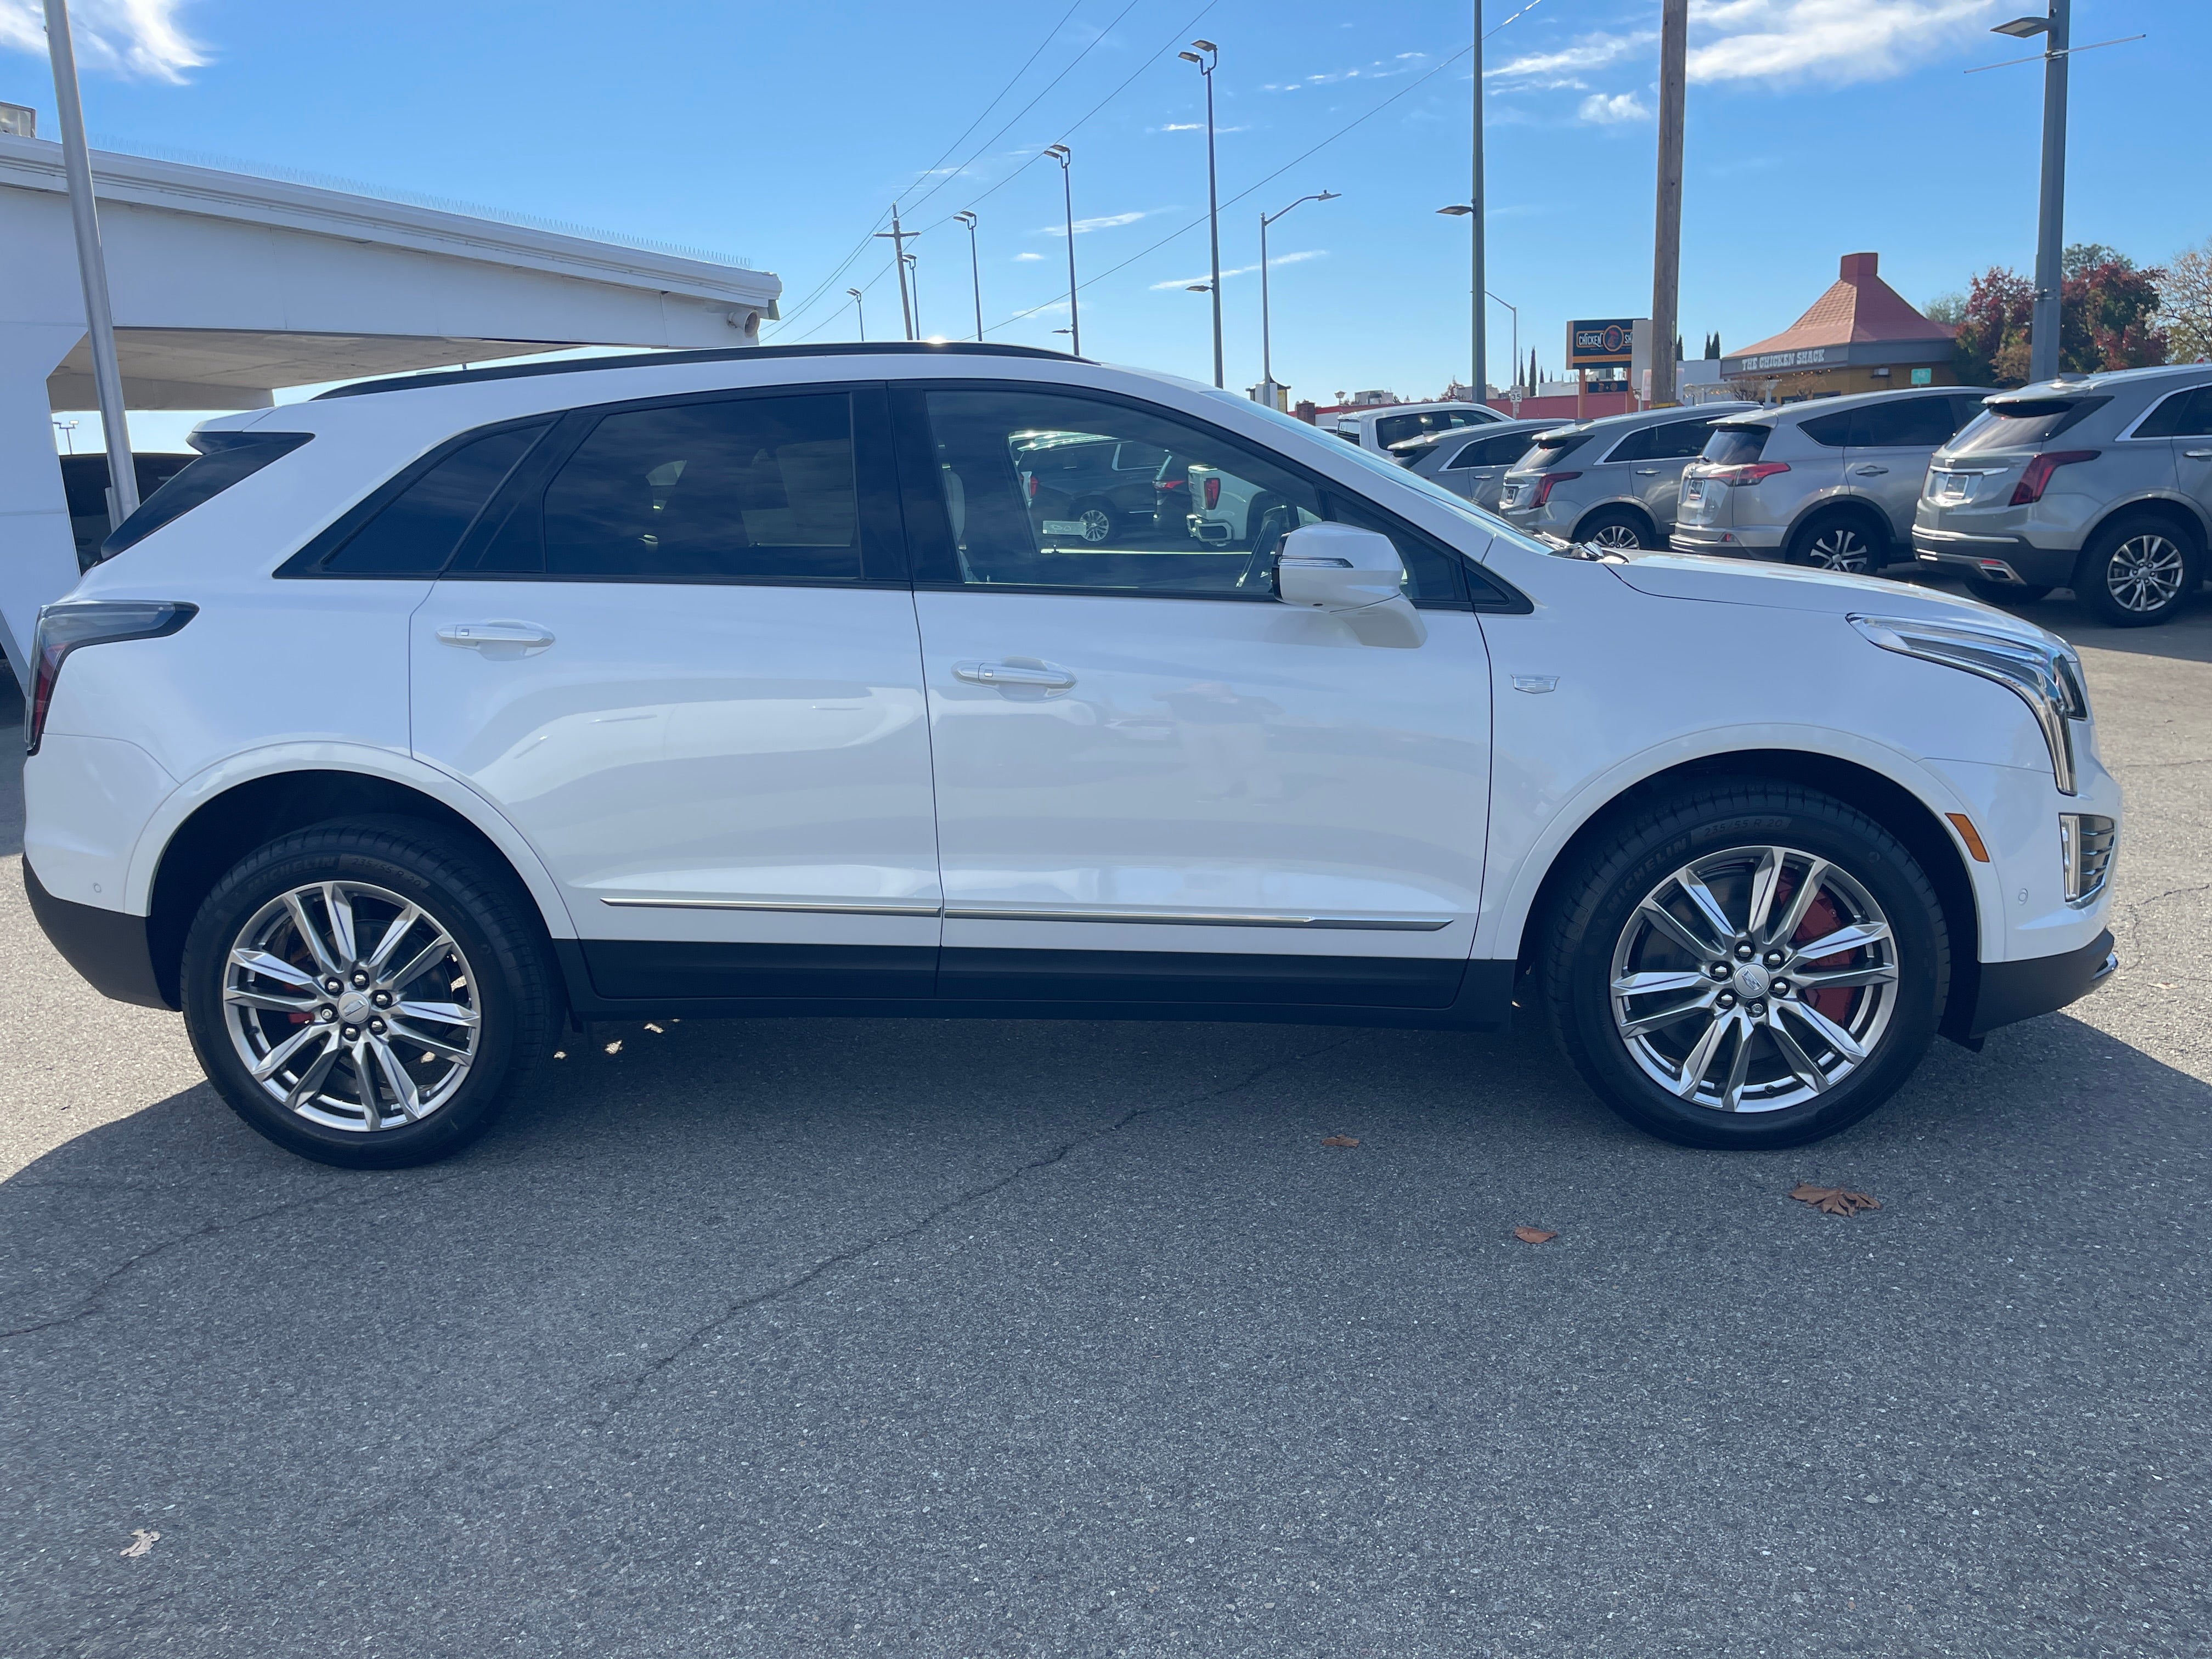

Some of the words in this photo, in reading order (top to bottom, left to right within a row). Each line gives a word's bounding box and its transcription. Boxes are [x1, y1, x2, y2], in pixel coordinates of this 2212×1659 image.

[1578, 332, 1604, 347] CHICKEN
[1742, 357, 1757, 371] THE
[1759, 353, 1796, 369] CHICKEN
[1796, 348, 1825, 365] SHACK
[1705, 819, 1748, 836] 235/55
[1754, 819, 1762, 827] R
[1768, 819, 1782, 827] 20
[352, 858, 393, 873] 235/55
[1607, 838, 1687, 914] MICHELIN
